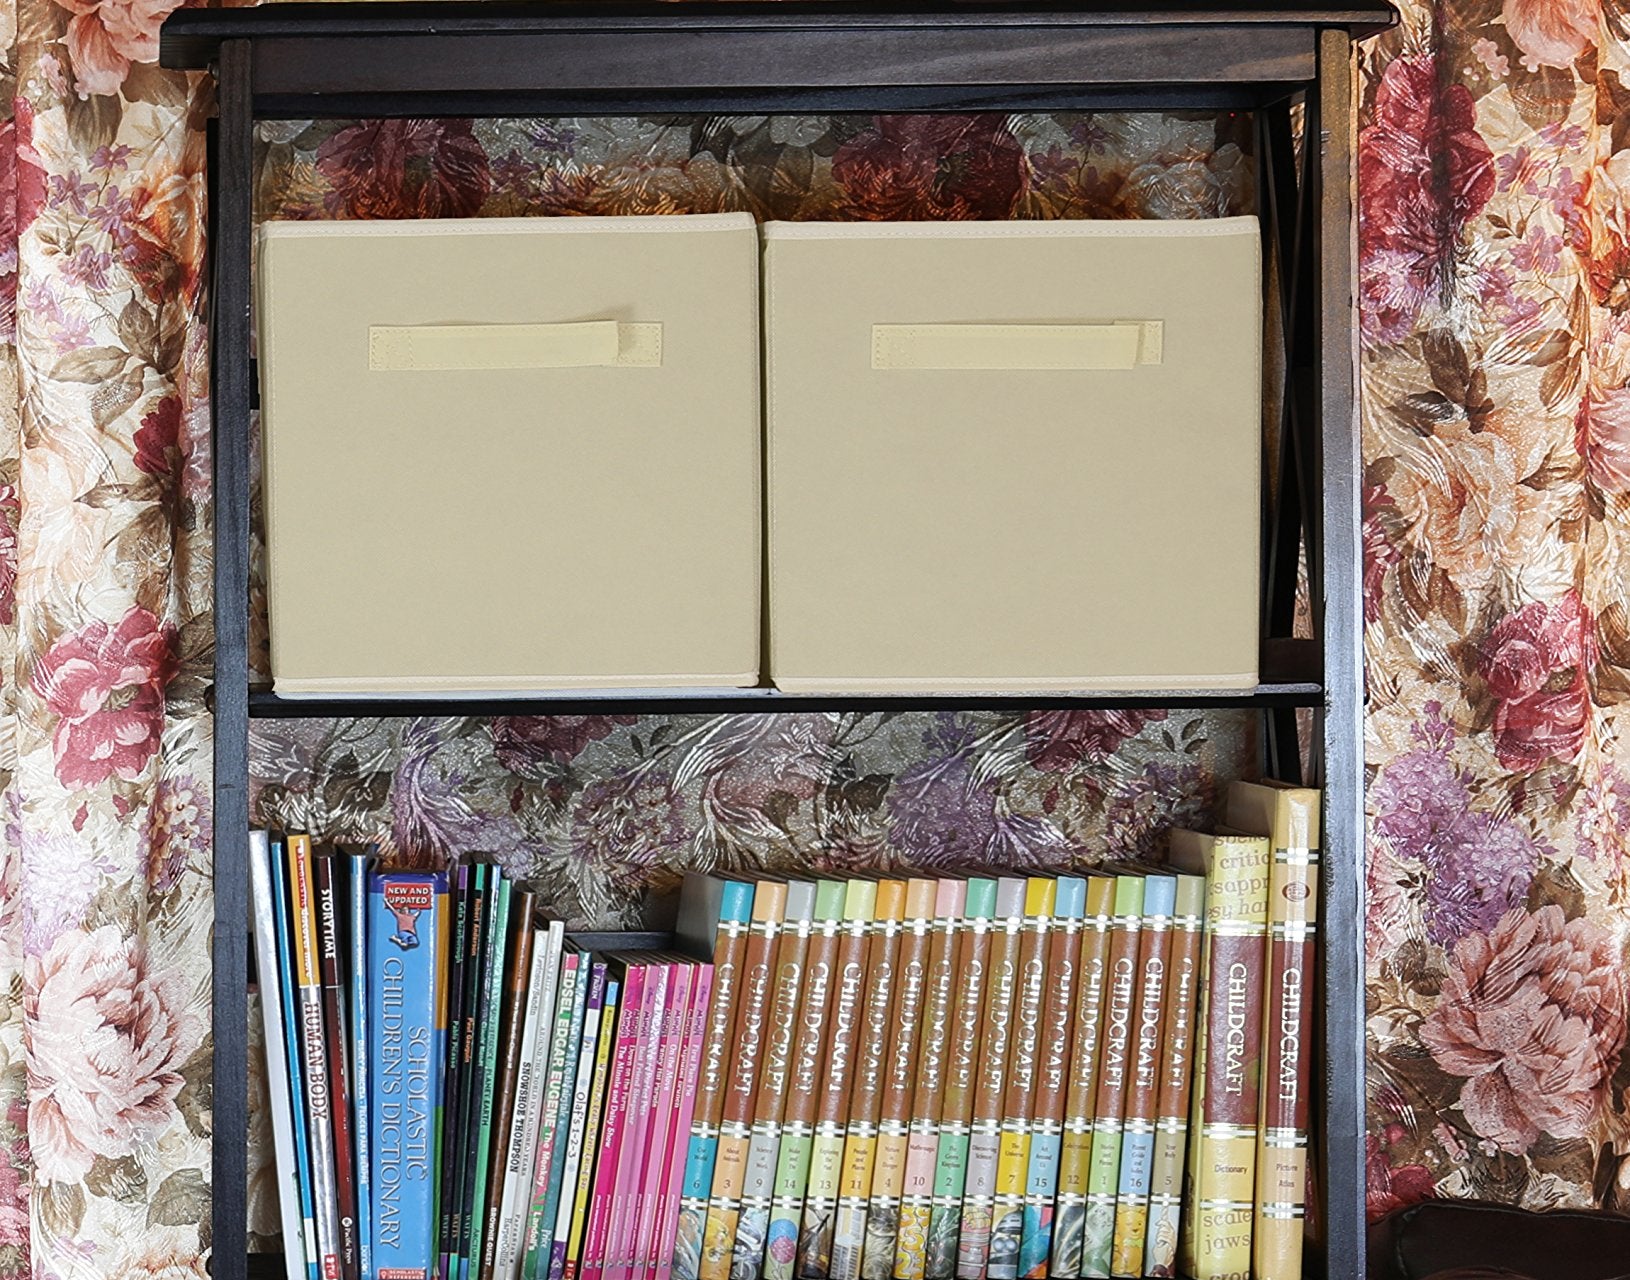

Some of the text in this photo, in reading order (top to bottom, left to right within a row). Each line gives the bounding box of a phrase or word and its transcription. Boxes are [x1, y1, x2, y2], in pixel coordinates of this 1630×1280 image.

[387, 887, 429, 895] NEW AND
[388, 896, 428, 904] UPDATED
[321, 889, 337, 959] STORYTIME
[454, 901, 465, 964] Kate Scarborough
[471, 898, 481, 956] Robert Anderson
[530, 954, 544, 1016] Levinson/Sandin
[560, 969, 576, 1014] EDSEL
[591, 974, 601, 999] FROZEN
[480, 1021, 488, 1044] Claude
[703, 963, 735, 1092] CHILDCRAFT
[734, 964, 769, 1096] CHILDCRAFT
[763, 963, 800, 1095] CHILDCRAFT
[795, 962, 829, 1095] CHILDCRAFT
[829, 962, 861, 1091] CHILDCRAFT
[863, 962, 891, 1091] CHILDCRAFT
[892, 961, 923, 1090] CHILDCRAFT
[922, 960, 952, 1092] CHILDCRAFT
[953, 960, 982, 1087] CHILDCRAFT
[983, 960, 1013, 1093] CHILDCRAFT
[1013, 959, 1043, 1092] CHILDCRAFT
[1043, 960, 1072, 1092] CHILDCRAFT
[1074, 958, 1102, 1090] CHILDCRAFT
[1105, 958, 1133, 1090] CHILDCRAFT
[1136, 957, 1164, 1090] CHILDCRAFT
[1225, 963, 1247, 1096] CHILDCRAFT
[1279, 968, 1301, 1104] CHILDCRAFT
[449, 1020, 459, 1069] Pablo Picasso
[463, 1017, 474, 1063] Paul Gauguin
[536, 1027, 546, 1056] AROUND
[553, 1018, 570, 1067] EDGAR
[626, 1044, 637, 1065] Down
[636, 1046, 646, 1061] Best
[657, 1044, 667, 1065] Fancy
[690, 1044, 700, 1062] First
[304, 1001, 328, 1119] HUMAN BODY
[534, 1059, 542, 1072] THE
[654, 1068, 663, 1081] Hat
[664, 1044, 678, 1091] On the Move
[687, 1064, 697, 1084] Place
[484, 1068, 493, 1098] PLANET
[623, 1079, 632, 1090] the
[633, 1063, 643, 1087] Friend
[380, 957, 404, 1249] CHILDREN'S DICTIONARY
[406, 1026, 429, 1181] SCHOLASTIC
[544, 1070, 564, 1127] EUGENE
[604, 1045, 628, 1148] The Minnie and Daisy Show
[620, 1092, 629, 1112] Farm
[652, 1083, 661, 1108] Parade
[686, 1085, 694, 1097] Pie
[482, 1100, 491, 1126] EARTH
[510, 1061, 531, 1173] SNOWSHOE THOMPSON
[628, 1088, 640, 1125] Sleepover
[639, 1101, 648, 1117] Pets
[525, 1117, 533, 1153] HUNDRED
[568, 1091, 587, 1158] Olaf's 1-2-3
[360, 1135, 369, 1153] PARA
[521, 1154, 529, 1176] YEARS
[536, 1130, 553, 1188] The Monkey
[1214, 1164, 1248, 1175] Dictionary
[1276, 1164, 1298, 1172] Picture
[693, 1180, 701, 1190] 6
[723, 1179, 731, 1189] 3
[756, 1178, 763, 1188] 9
[784, 1179, 796, 1190] 14
[820, 1180, 832, 1190] 13
[851, 1180, 862, 1190] 11
[913, 1176, 925, 1187] 10
[945, 1177, 953, 1187] 2
[1008, 1174, 1016, 1184] 7
[1034, 1177, 1047, 1188] 15
[1067, 1174, 1080, 1185] 12
[1102, 1175, 1106, 1185] 1
[1130, 1177, 1142, 1188] 16
[1164, 1175, 1172, 1186] 5
[1279, 1180, 1295, 1188] Atlas
[451, 1214, 459, 1238] WATTS
[463, 1214, 471, 1239] WATTS
[484, 1207, 497, 1267] BROWNIE QUEST
[528, 1212, 541, 1251] Landoll's
[540, 1229, 552, 1249] Price
[343, 1227, 353, 1264] Pacific Press
[499, 1217, 513, 1267] HarperCollins
[1204, 1234, 1251, 1255] jaws
